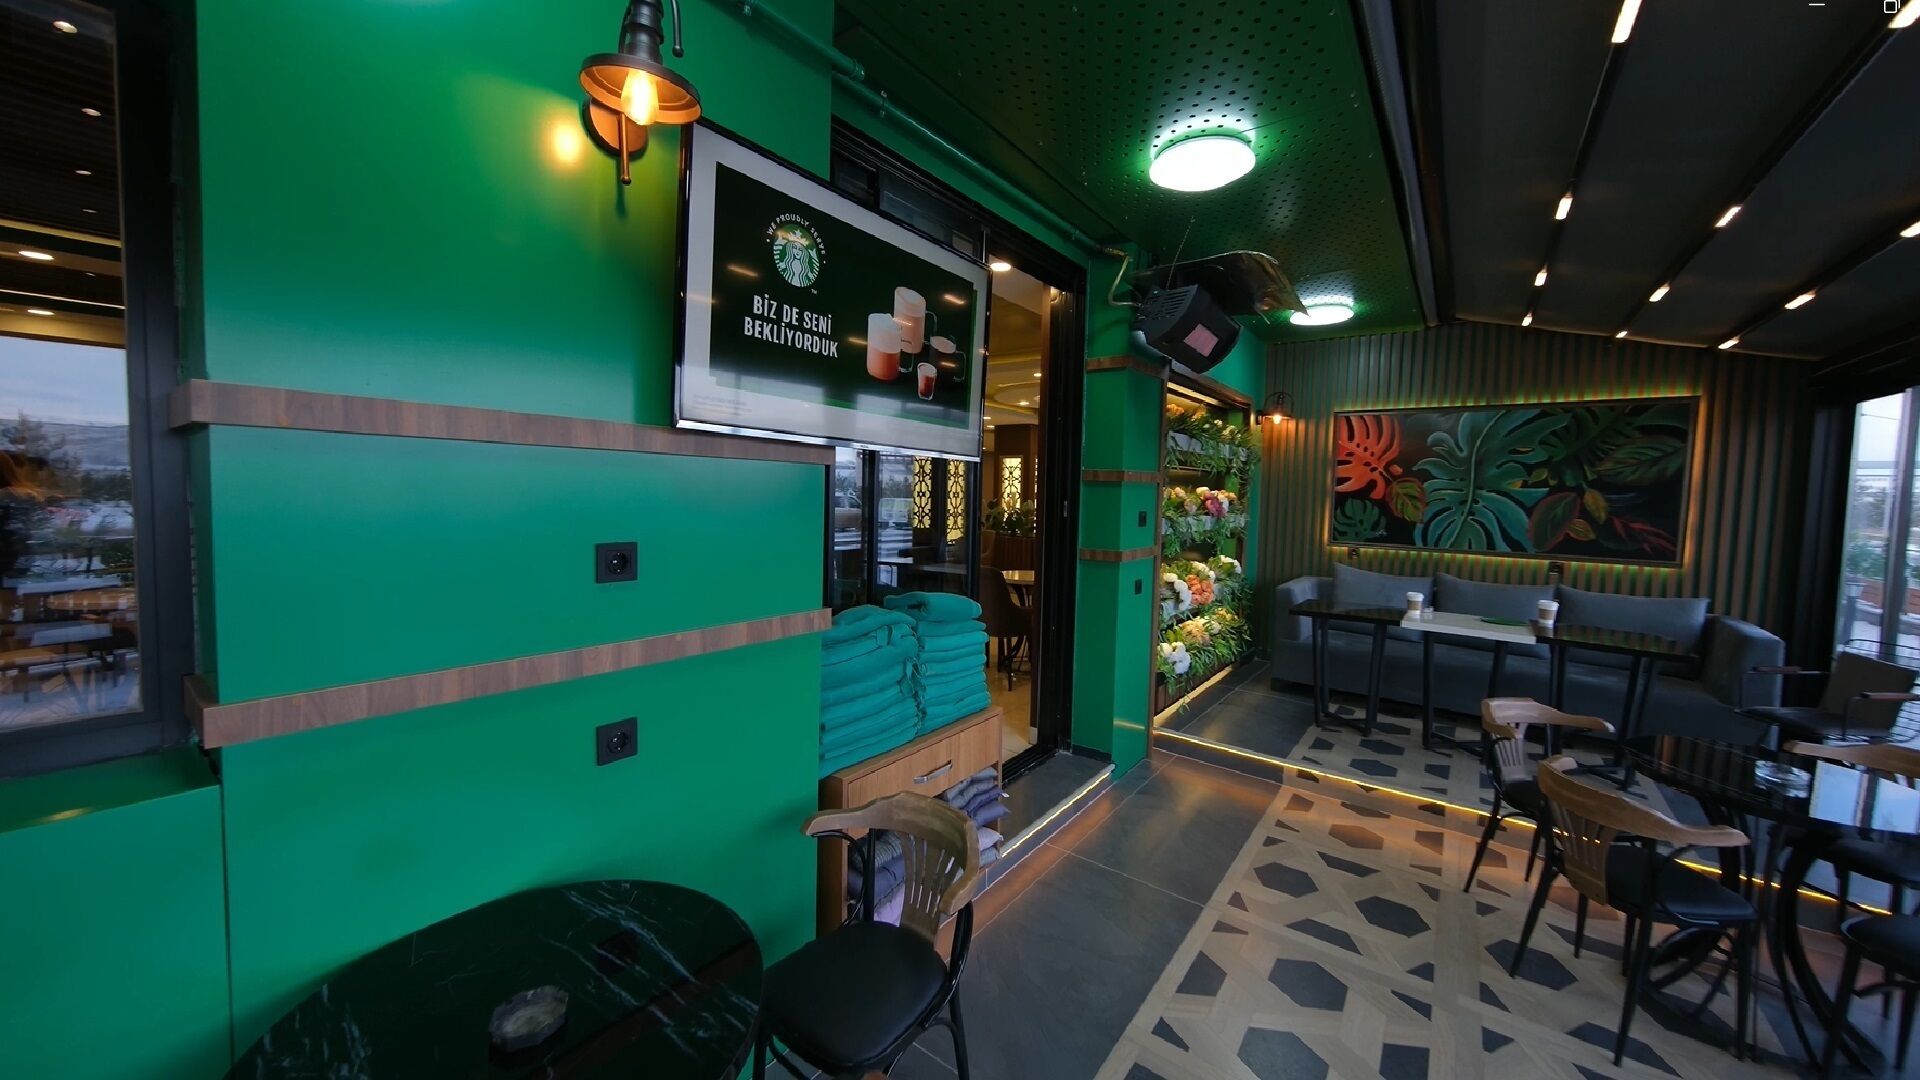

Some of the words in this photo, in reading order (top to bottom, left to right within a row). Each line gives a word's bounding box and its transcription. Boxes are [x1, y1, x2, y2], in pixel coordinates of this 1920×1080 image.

[767, 222, 777, 235] WE
[776, 213, 810, 228] PROUDLY
[753, 293, 778, 319] BİZ
[782, 303, 800, 326] DE
[803, 310, 832, 335] SENİ
[744, 316, 838, 358] BEKLİYORDUK
